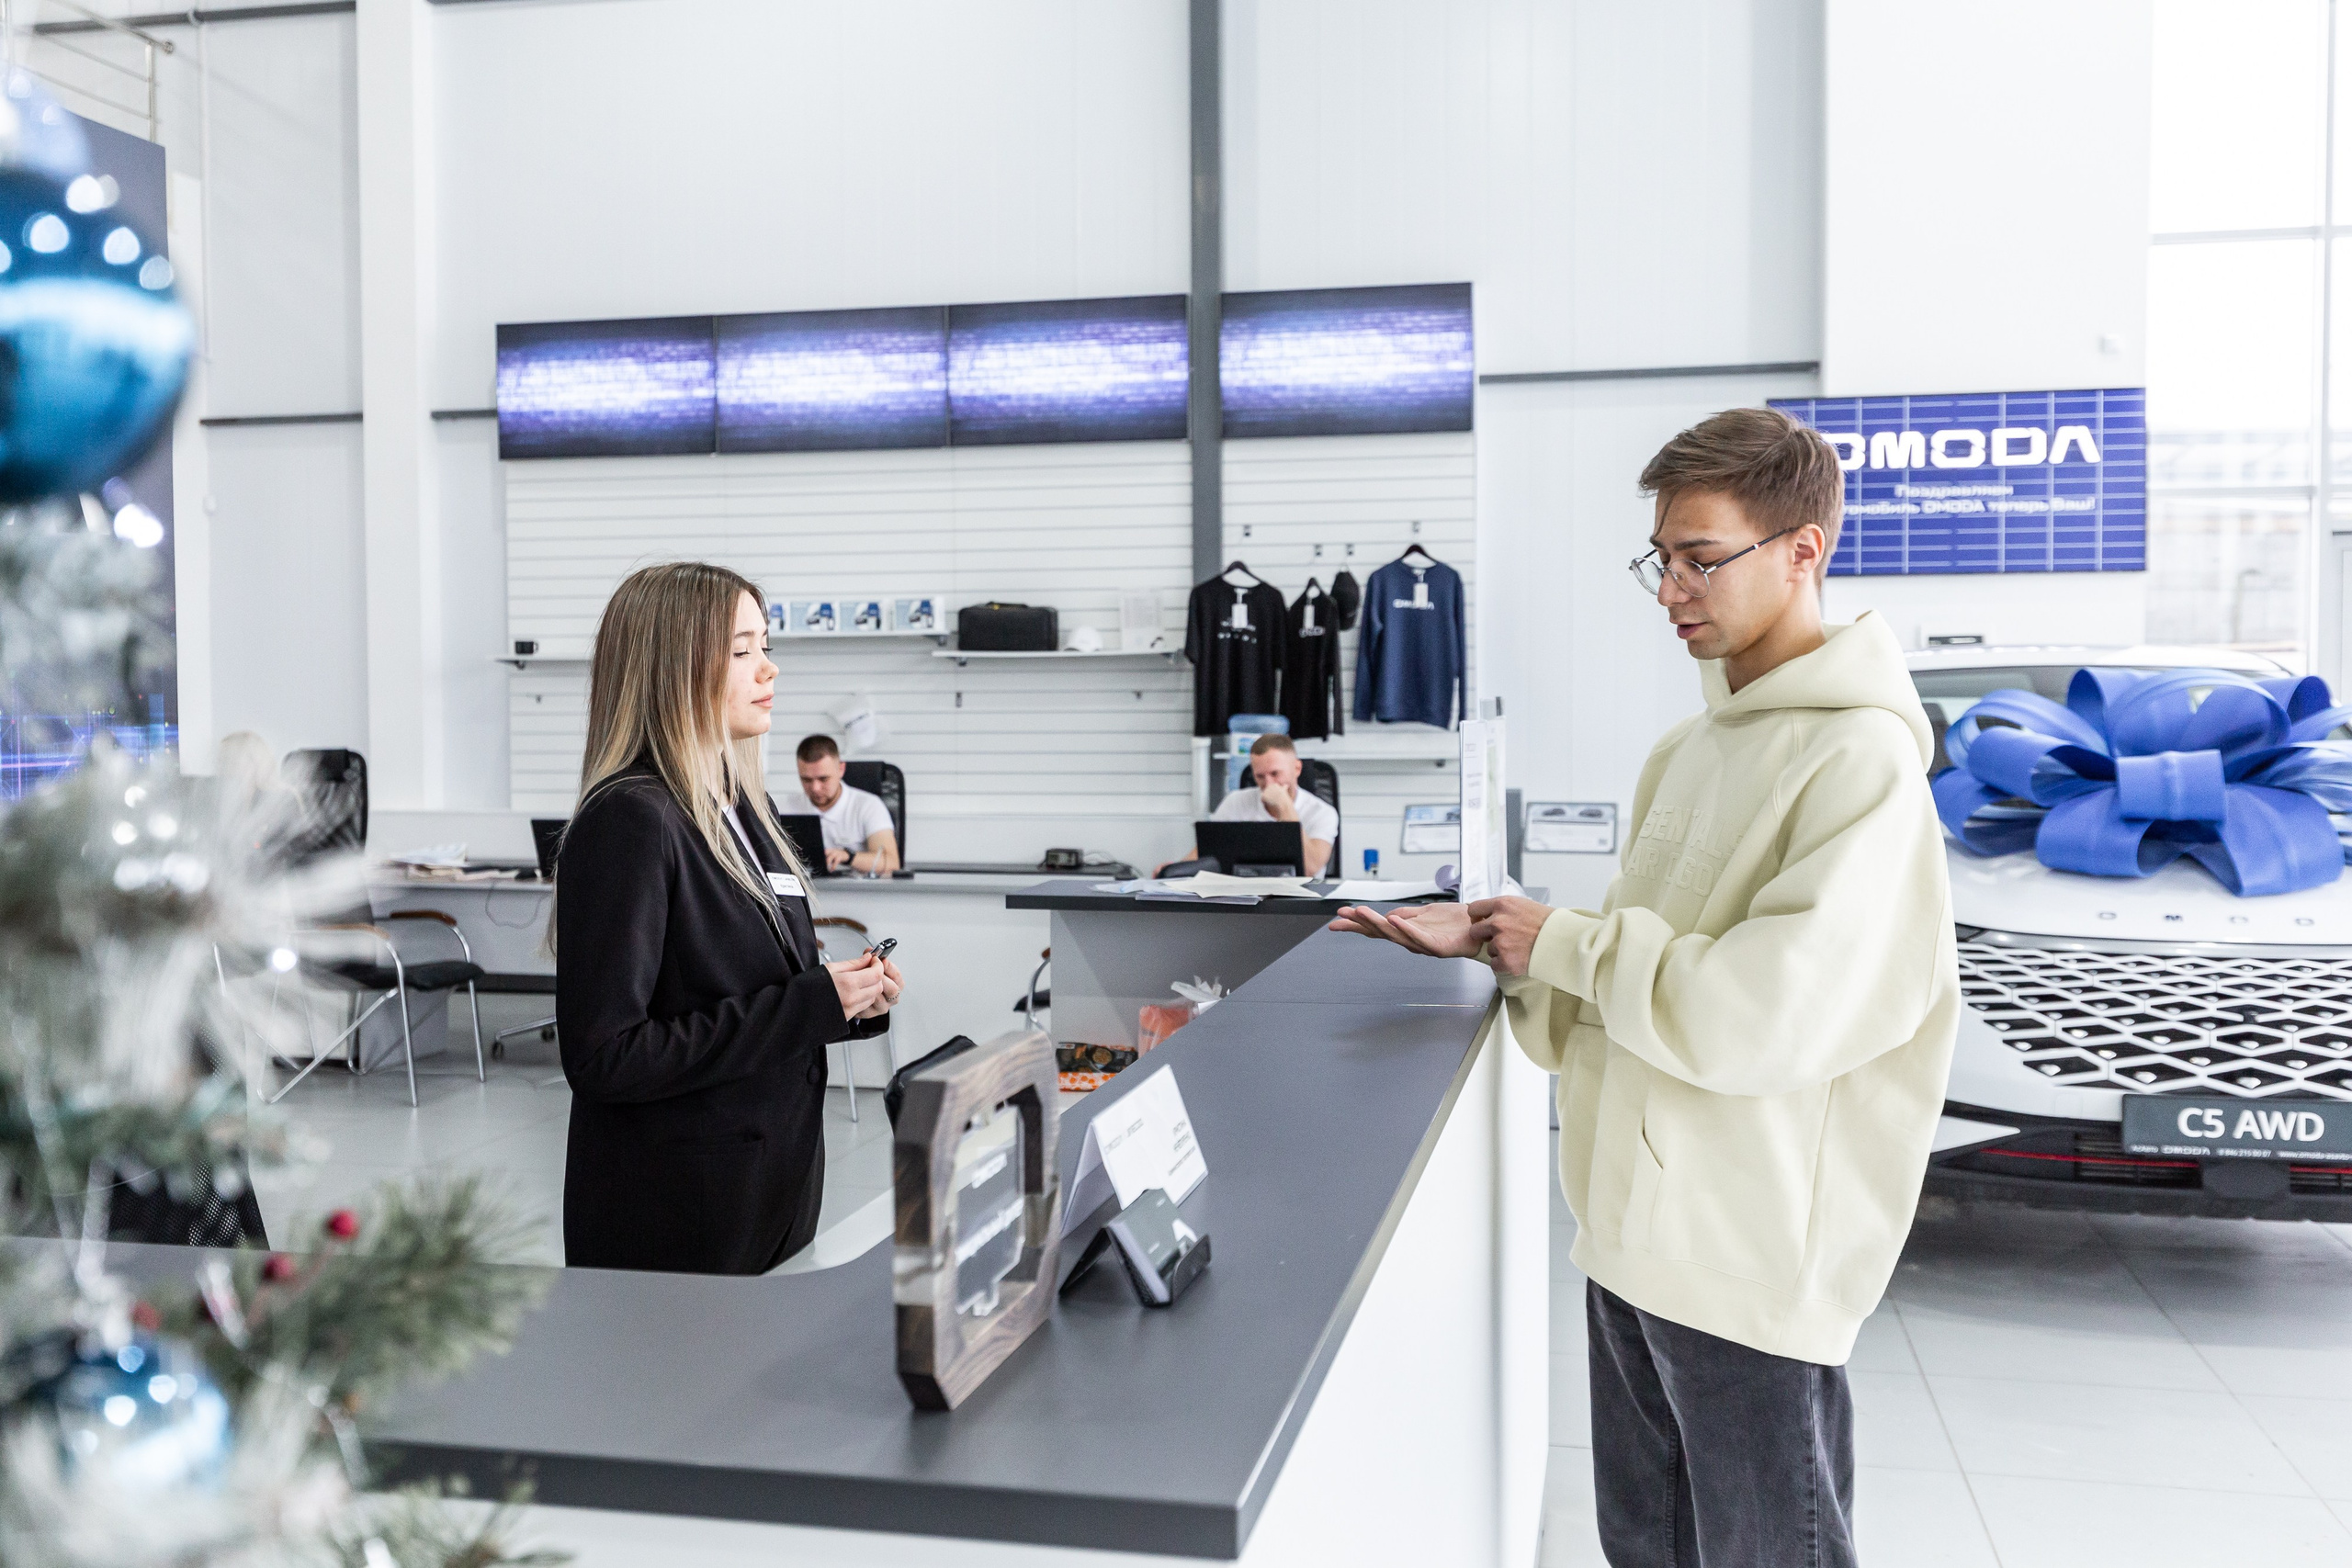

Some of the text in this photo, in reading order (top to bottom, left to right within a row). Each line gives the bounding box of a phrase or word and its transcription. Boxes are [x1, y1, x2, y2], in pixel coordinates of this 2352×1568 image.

[1822, 424, 2101, 471] OMODA
[1894, 484, 2014, 499] Поздравляем
[1922, 498, 1985, 514] OMODA
[1624, 845, 1660, 880] AR
[2177, 1107, 2325, 1142] C5 AWD
[2161, 1144, 2211, 1156] OMODA
